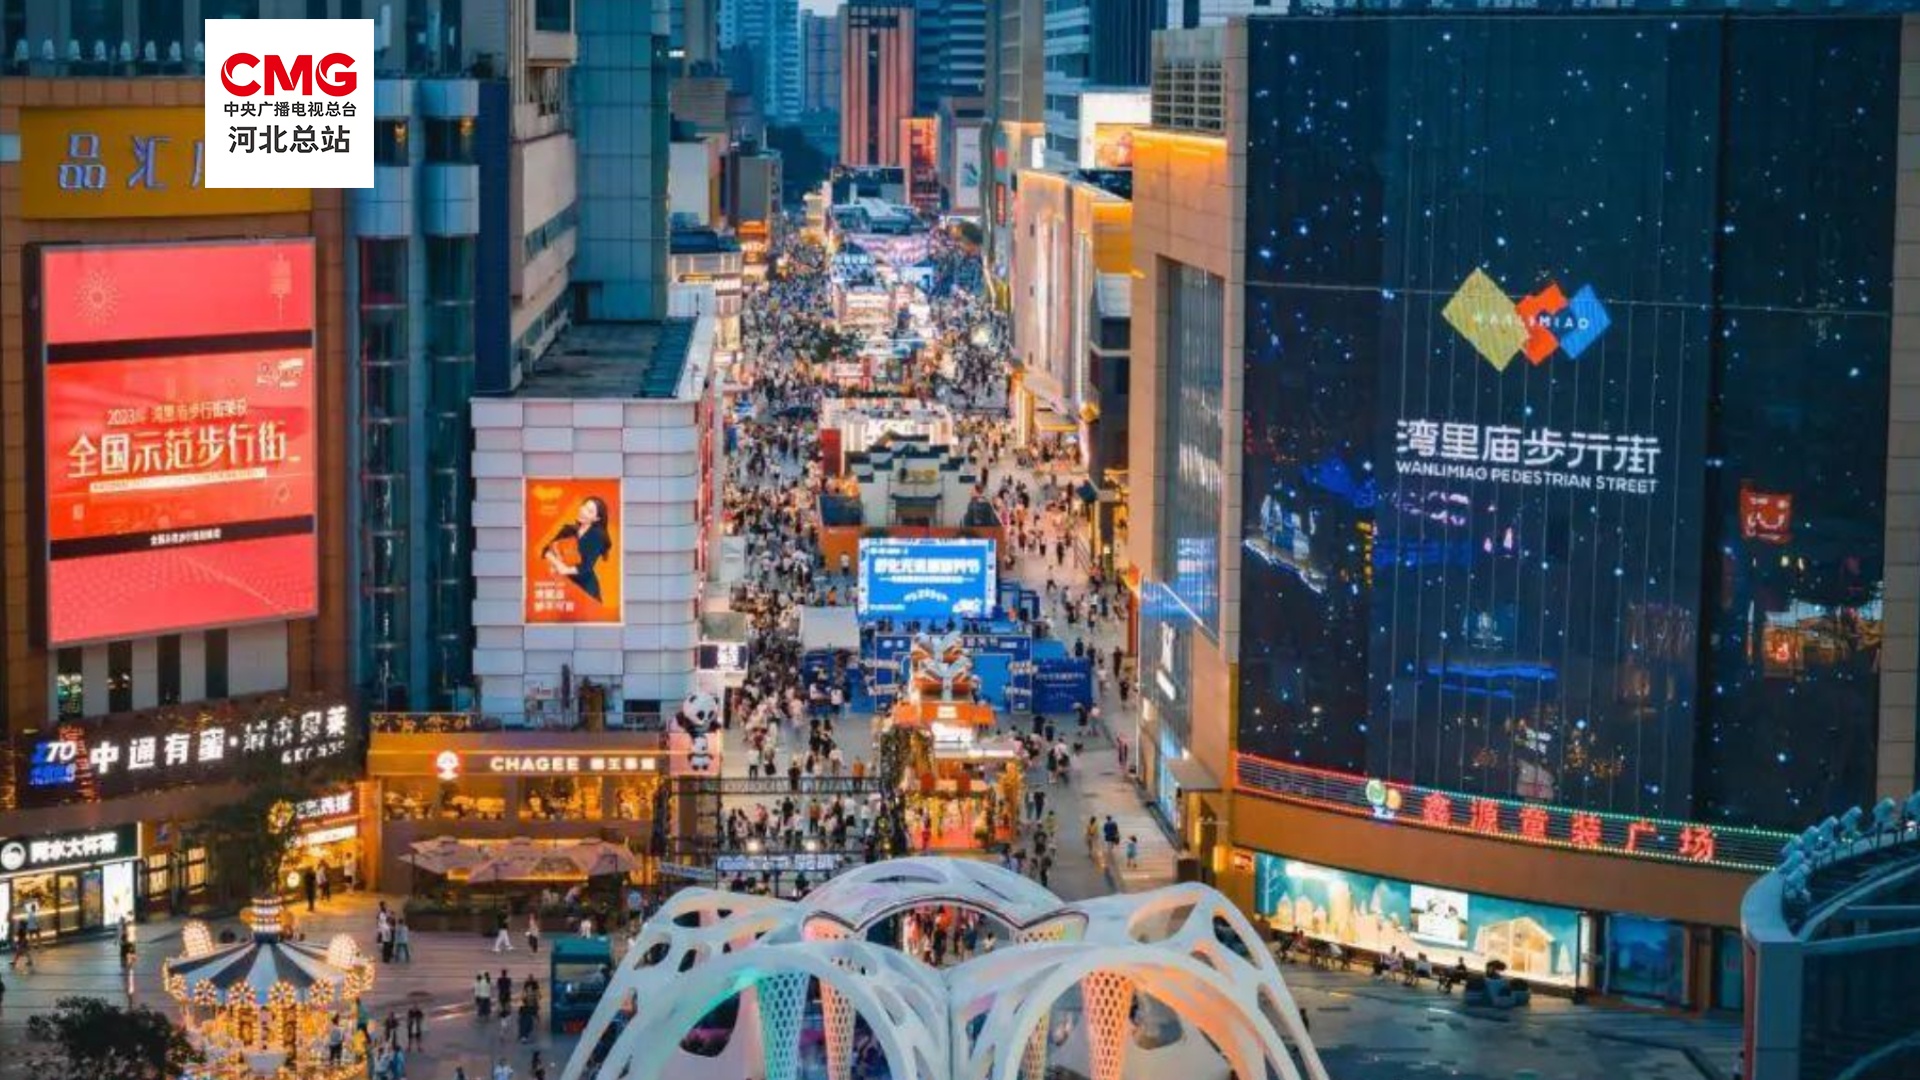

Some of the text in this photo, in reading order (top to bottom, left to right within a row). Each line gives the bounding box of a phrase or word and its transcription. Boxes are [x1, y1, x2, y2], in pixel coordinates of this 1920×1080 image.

[58, 133, 205, 190] 品汇
[68, 420, 286, 478] 全国示范步行街
[1396, 419, 1661, 474] 湾里庙步行街
[1395, 460, 1658, 494] WANLIMIAO PEDESTRIAN STREET
[490, 756, 579, 772] CHAGEE
[1422, 789, 1717, 862] 鑫源童装广场
